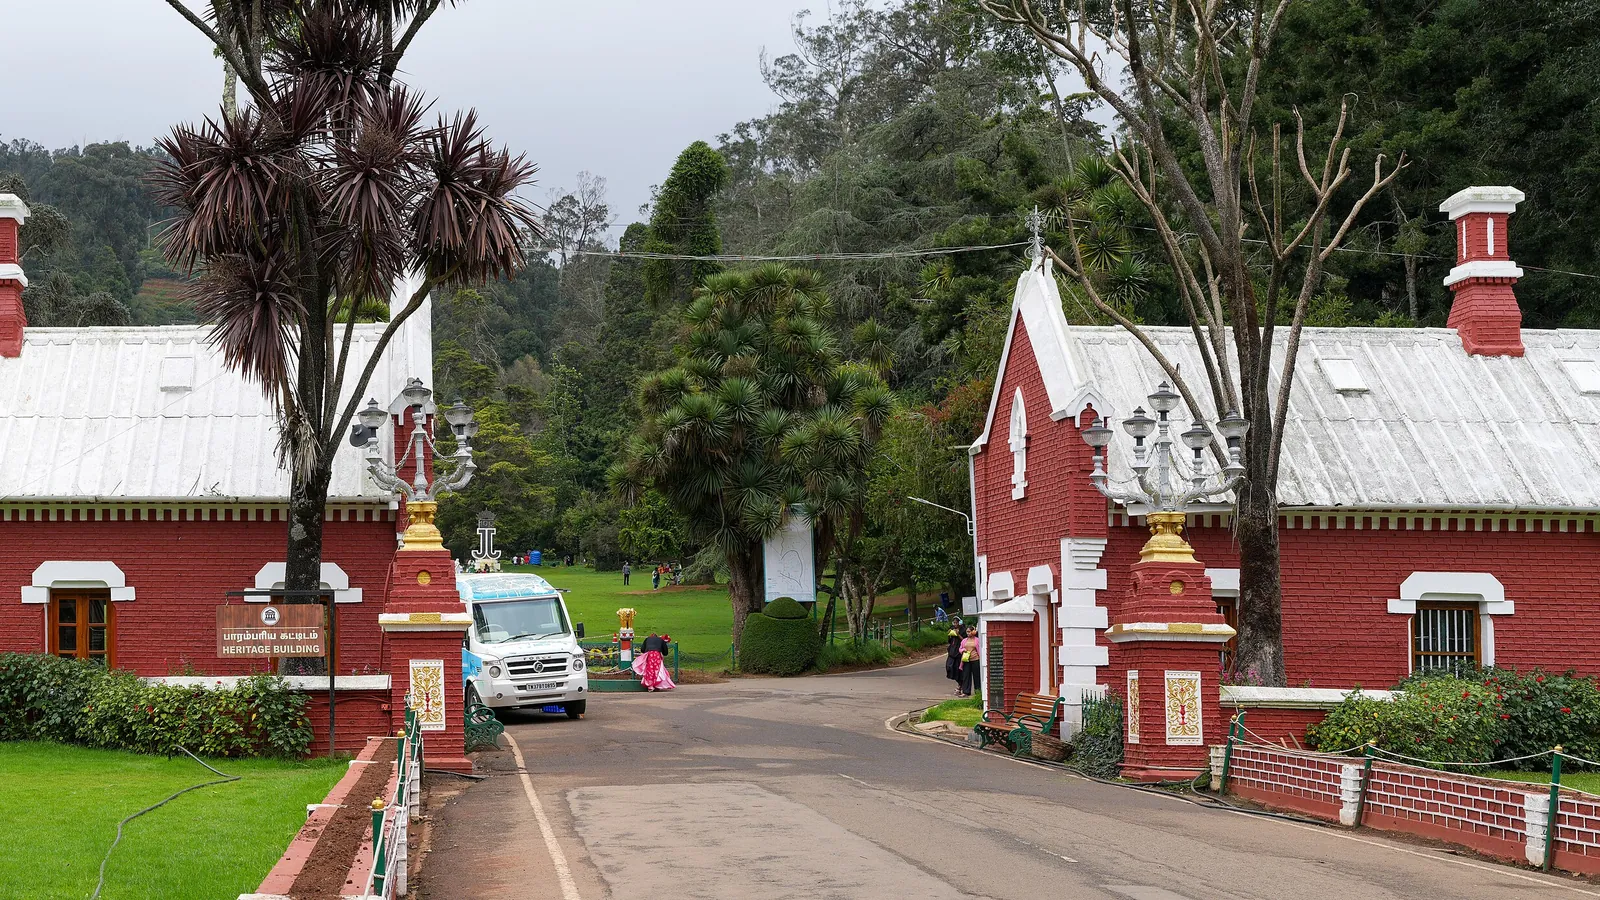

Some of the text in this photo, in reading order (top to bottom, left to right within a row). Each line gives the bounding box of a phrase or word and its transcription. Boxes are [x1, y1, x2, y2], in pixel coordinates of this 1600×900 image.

[223, 630, 318, 642] பாரம்பரிய கட்டிடம்
[222, 645, 320, 654] HERITAGE BUILDING
